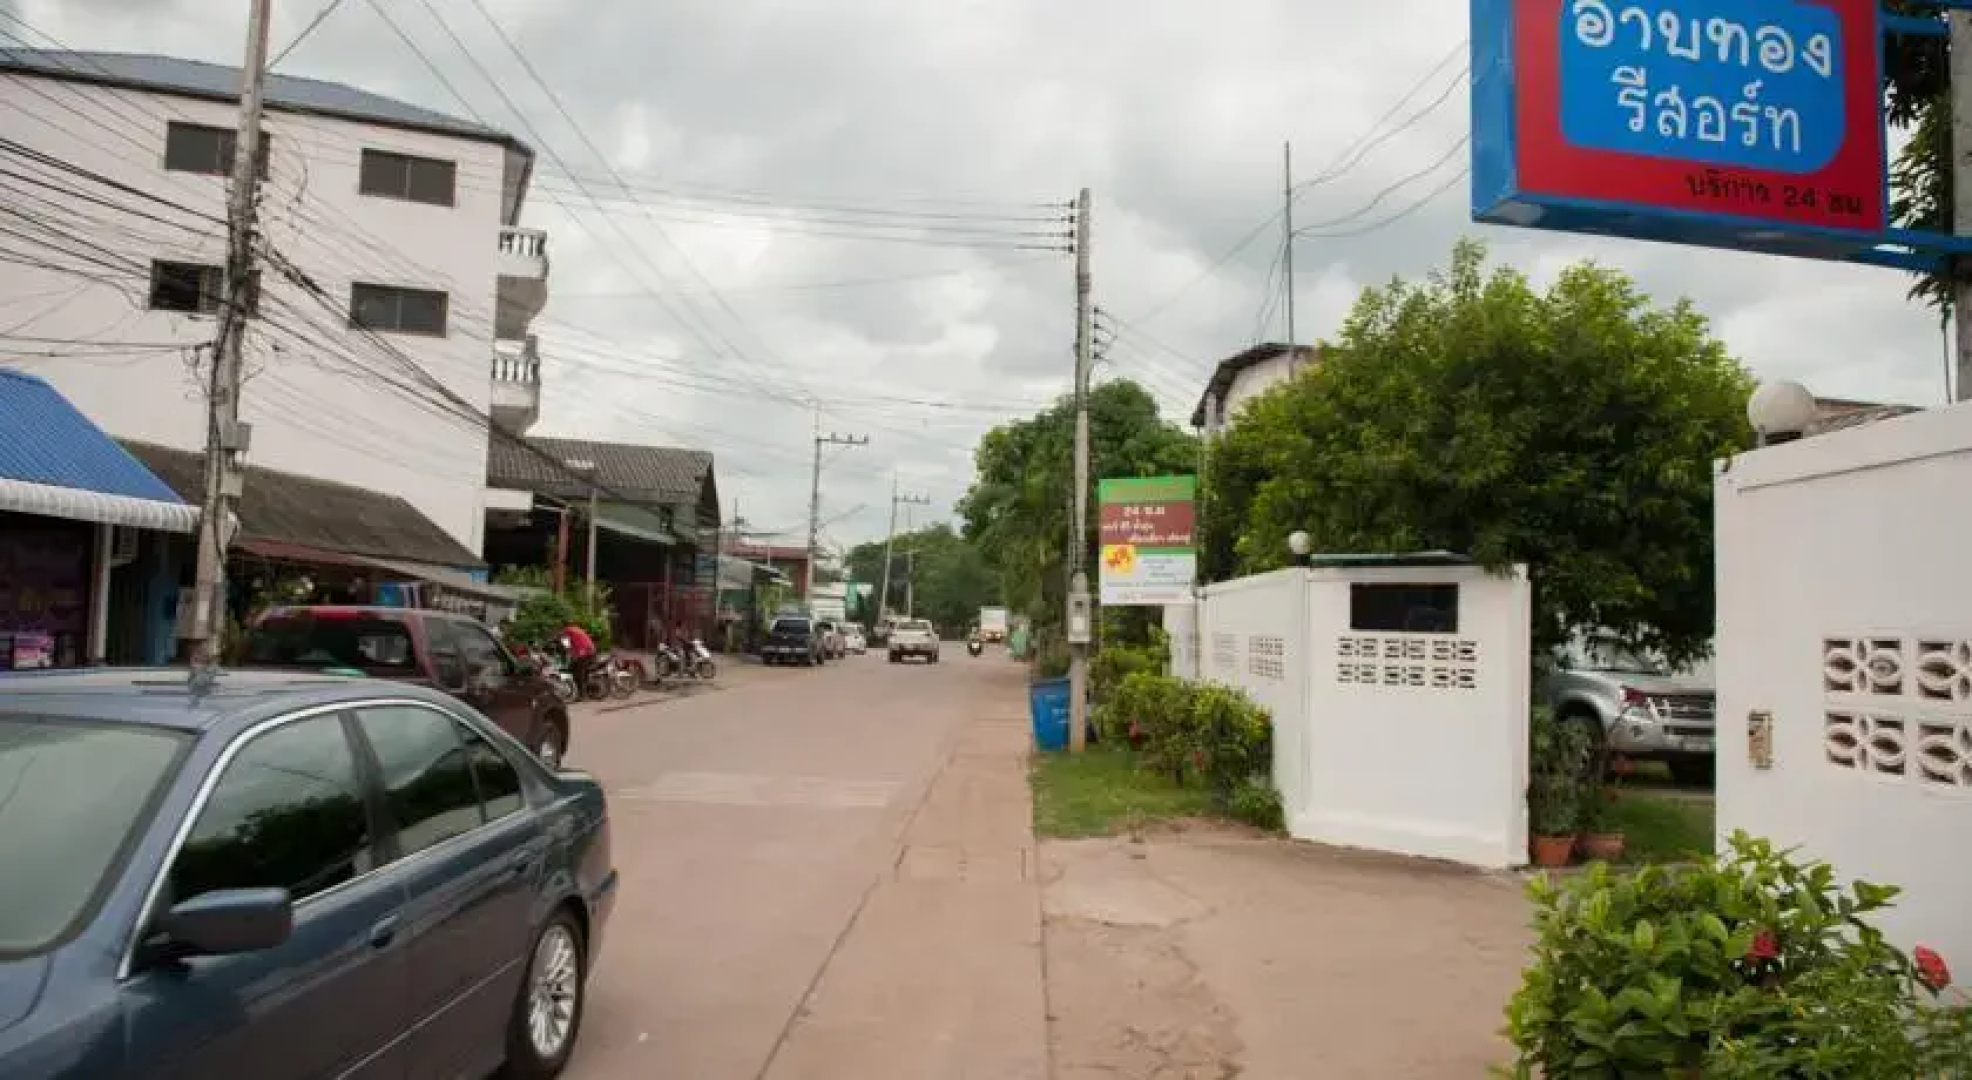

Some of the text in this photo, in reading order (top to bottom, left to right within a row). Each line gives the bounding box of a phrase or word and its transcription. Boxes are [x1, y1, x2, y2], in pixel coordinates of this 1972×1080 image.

[1611, 65, 1801, 153] รีสอร์ท
[1783, 185, 1816, 208] 24
